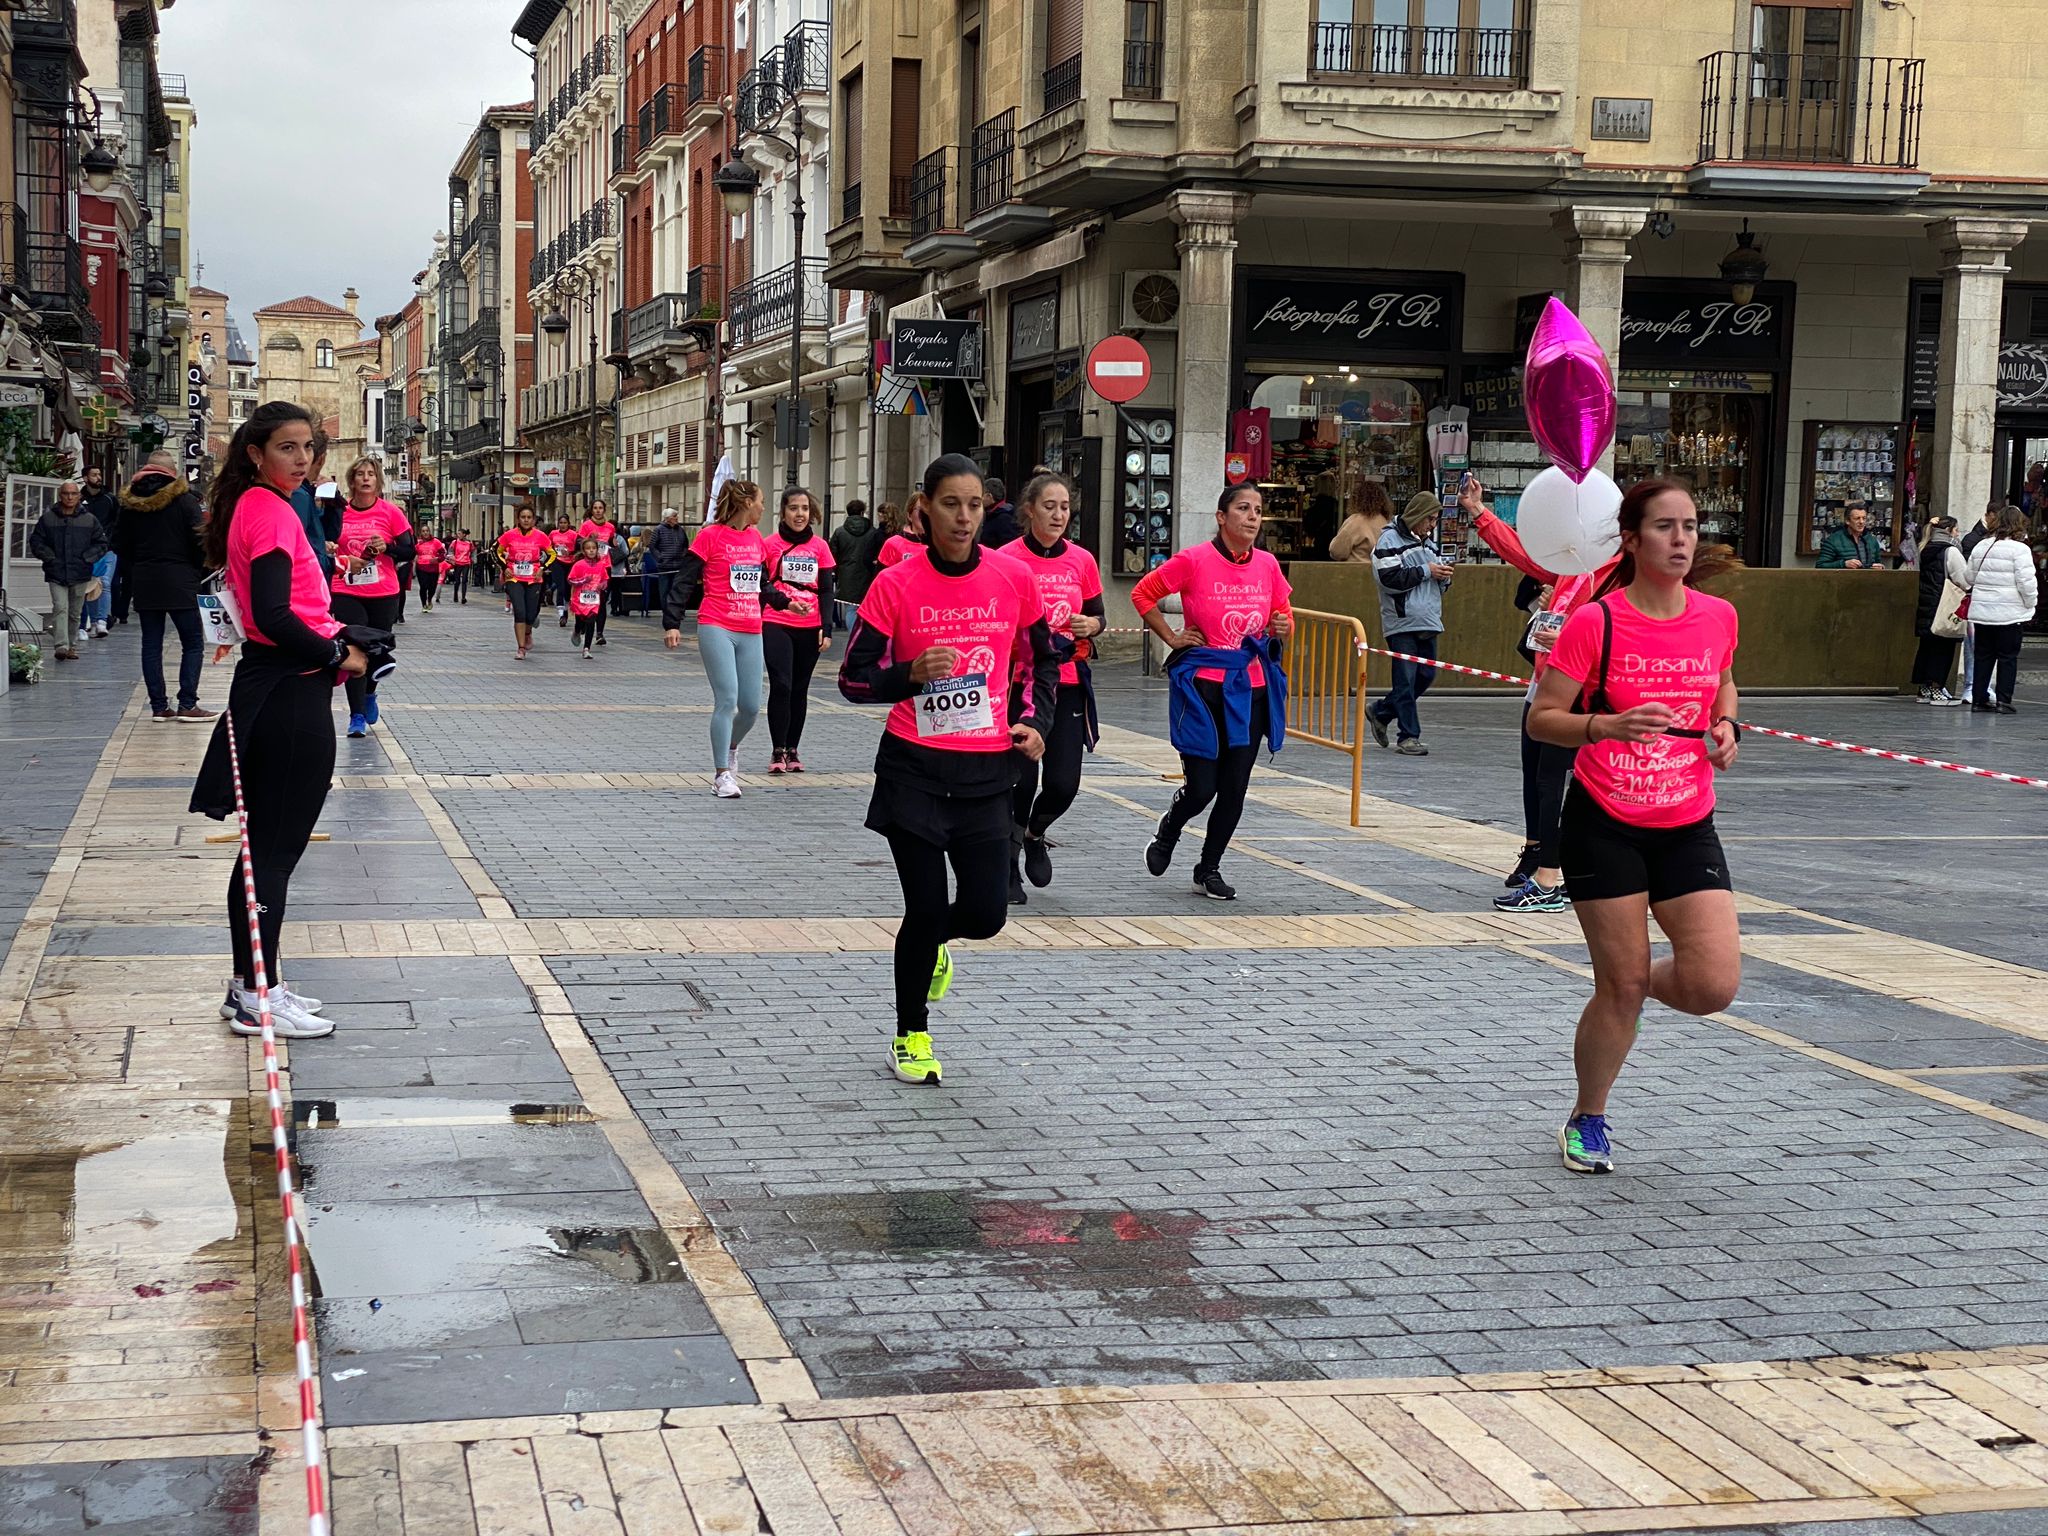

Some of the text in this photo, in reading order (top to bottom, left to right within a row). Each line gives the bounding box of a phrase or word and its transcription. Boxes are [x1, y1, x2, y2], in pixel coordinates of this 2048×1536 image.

[1606, 112, 1638, 121] PLAZA
[1598, 125, 1645, 134] DE REGLA
[898, 327, 948, 350] Regalos
[898, 352, 953, 369] Souvenir
[1476, 397, 1498, 412] DE
[788, 563, 814, 572] 3986
[734, 572, 759, 581] 4026
[1213, 579, 1264, 594] Drasanvi
[920, 597, 998, 624] Drasanvi
[969, 621, 1009, 630] CAROBELS
[1625, 648, 1712, 673] Drasanvi
[923, 690, 980, 713] 4009
[1609, 752, 1699, 772] VIII CARRERA
